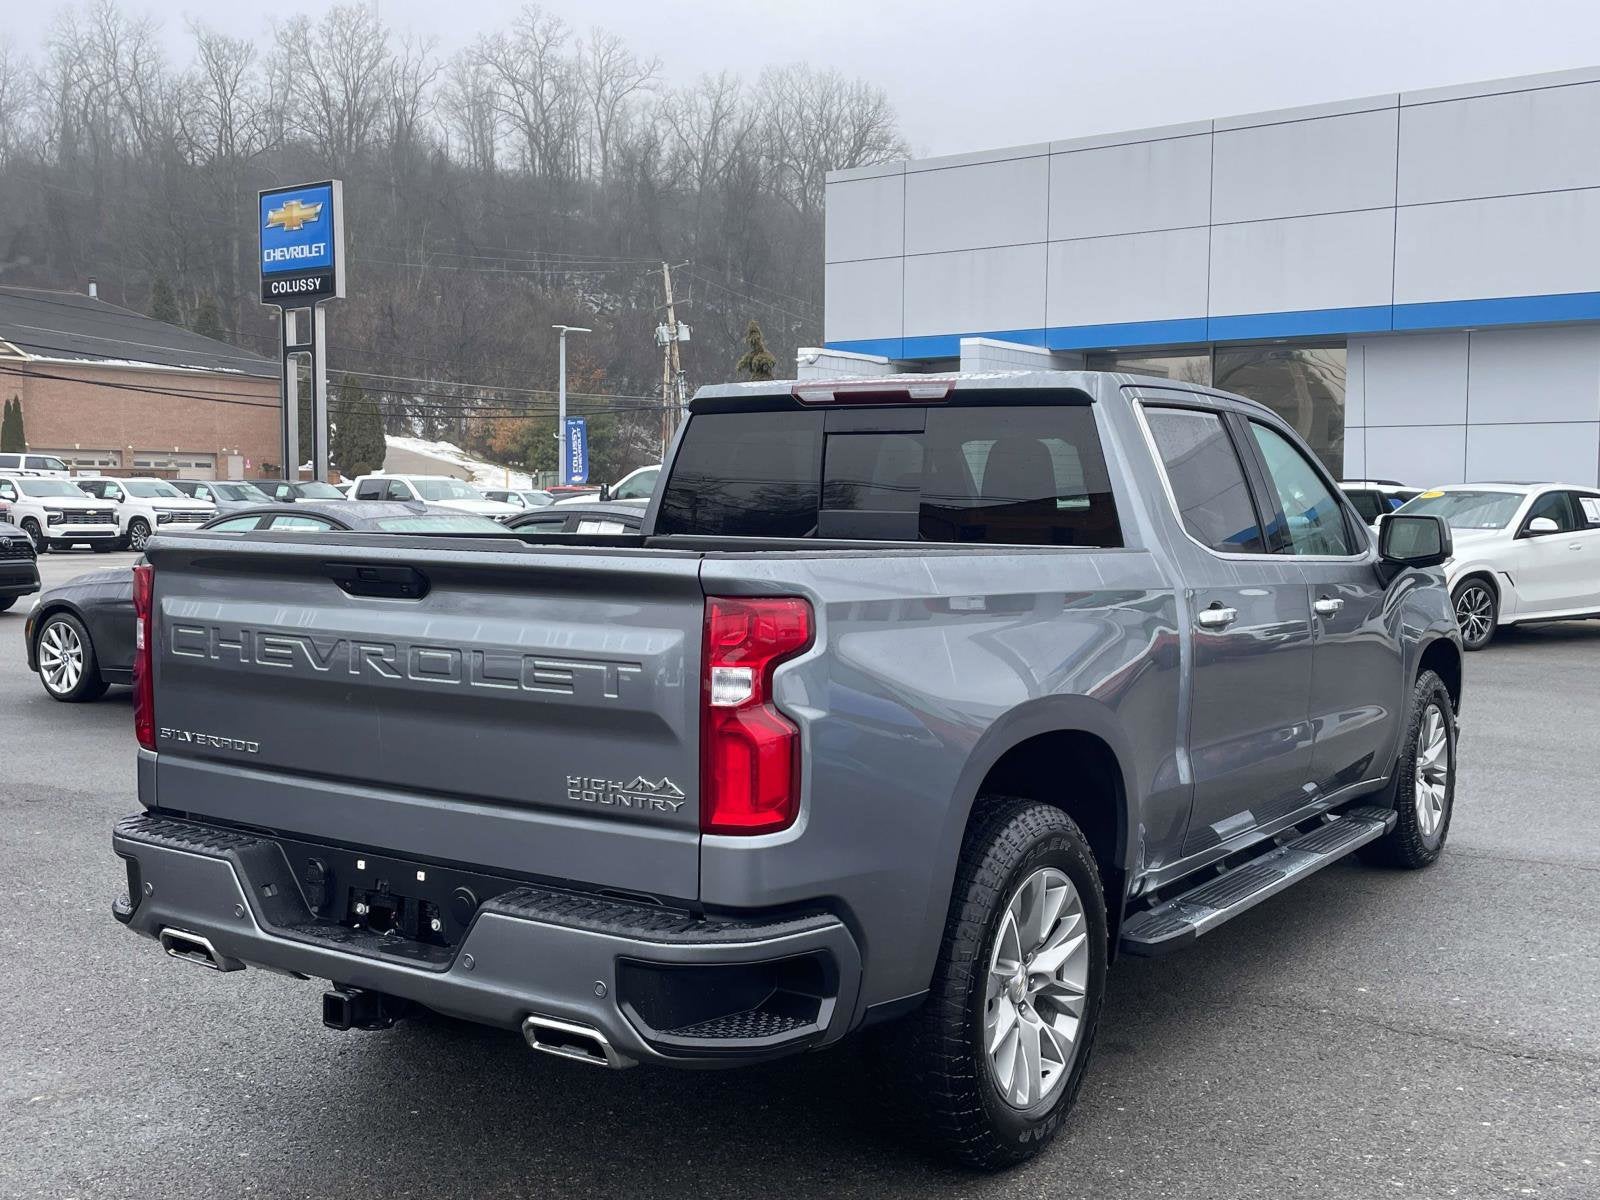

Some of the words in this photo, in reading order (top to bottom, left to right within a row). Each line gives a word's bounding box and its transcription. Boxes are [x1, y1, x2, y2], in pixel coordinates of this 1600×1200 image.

[263, 243, 326, 262] CHEVROLET
[271, 278, 321, 294] COLUSSY
[171, 623, 642, 699] CHEVROLET
[160, 727, 259, 753] SILVERADO
[566, 775, 624, 792] HIGH
[567, 788, 685, 813] COUNTRY
